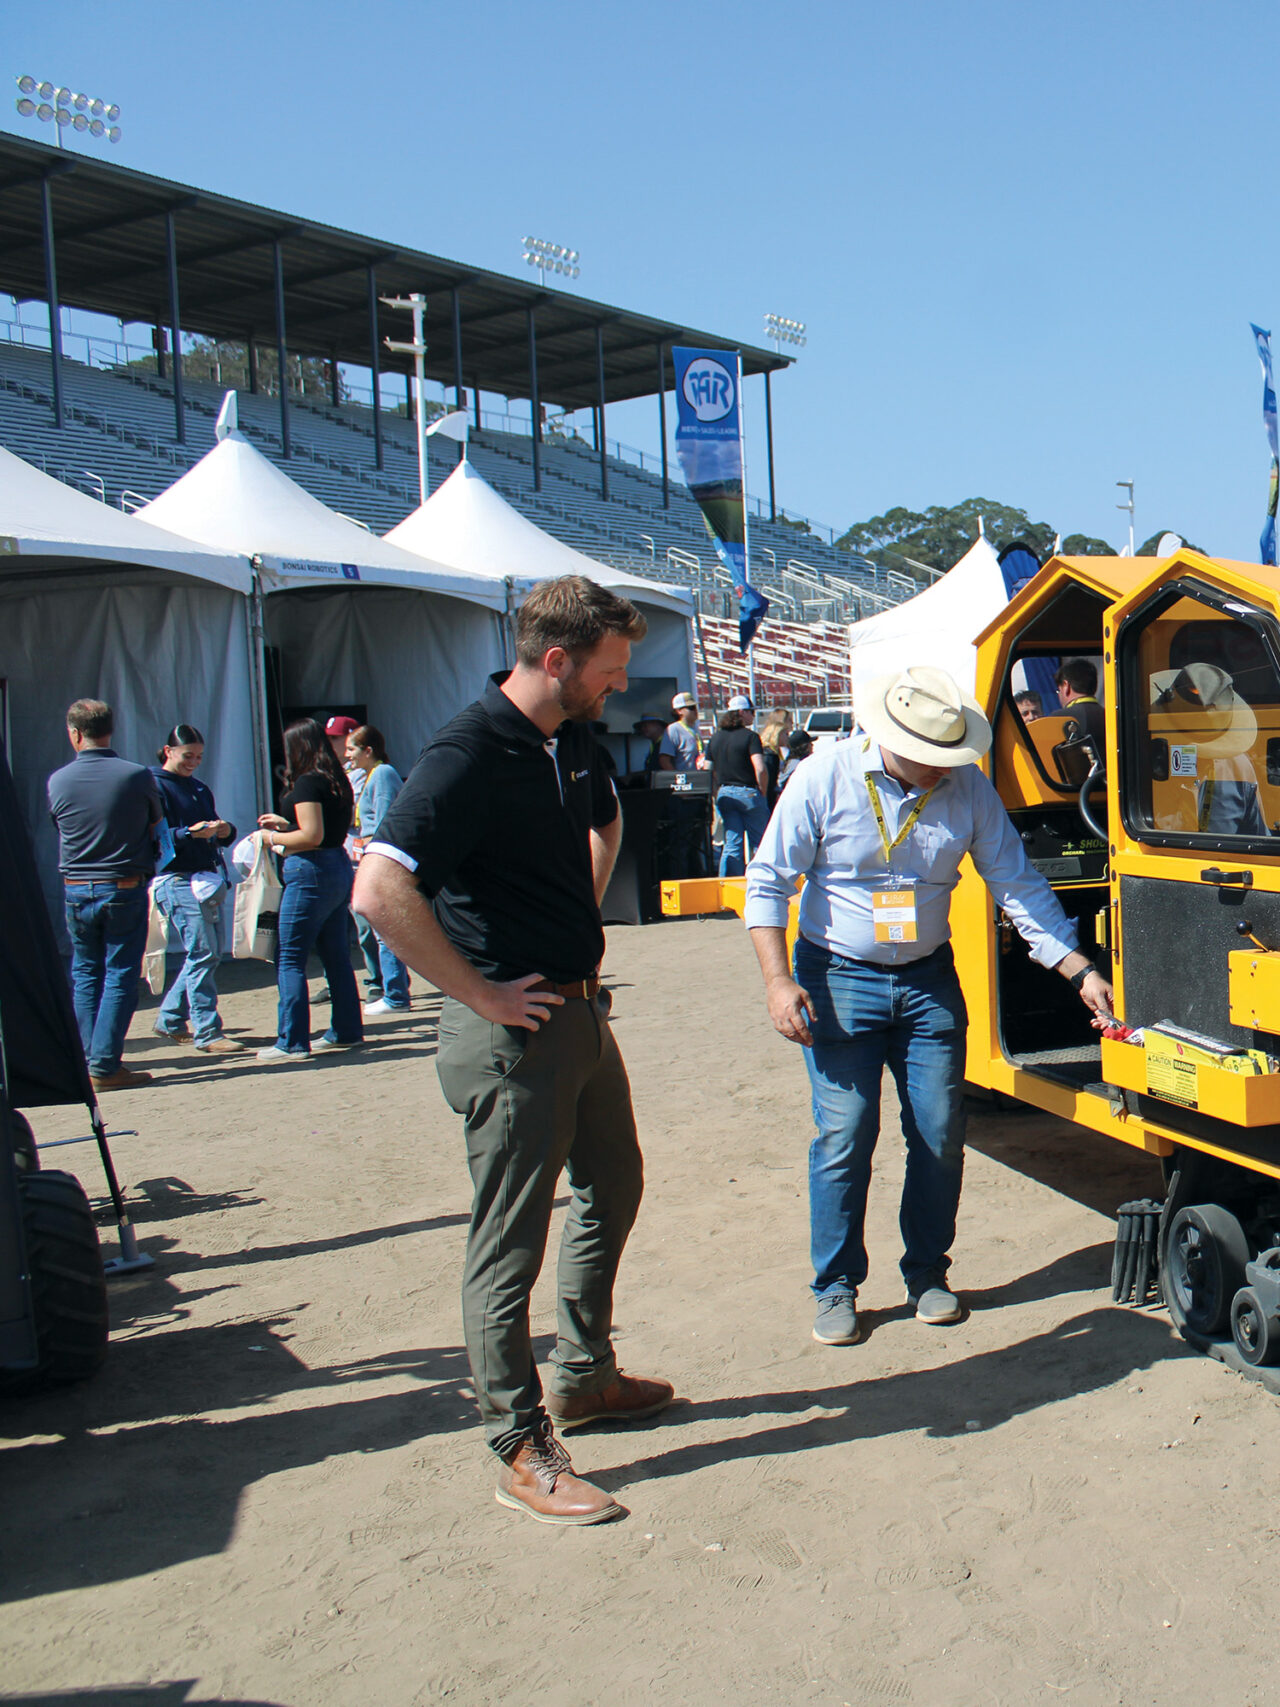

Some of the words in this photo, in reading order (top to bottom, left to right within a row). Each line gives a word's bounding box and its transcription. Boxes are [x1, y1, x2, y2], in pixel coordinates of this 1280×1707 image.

[282, 561, 306, 572] BONSAI
[307, 563, 339, 574] ROBOTICS
[1079, 839, 1109, 849] SHO
[1151, 1053, 1172, 1066] CAUTION
[1173, 1059, 1196, 1075] WARNING
